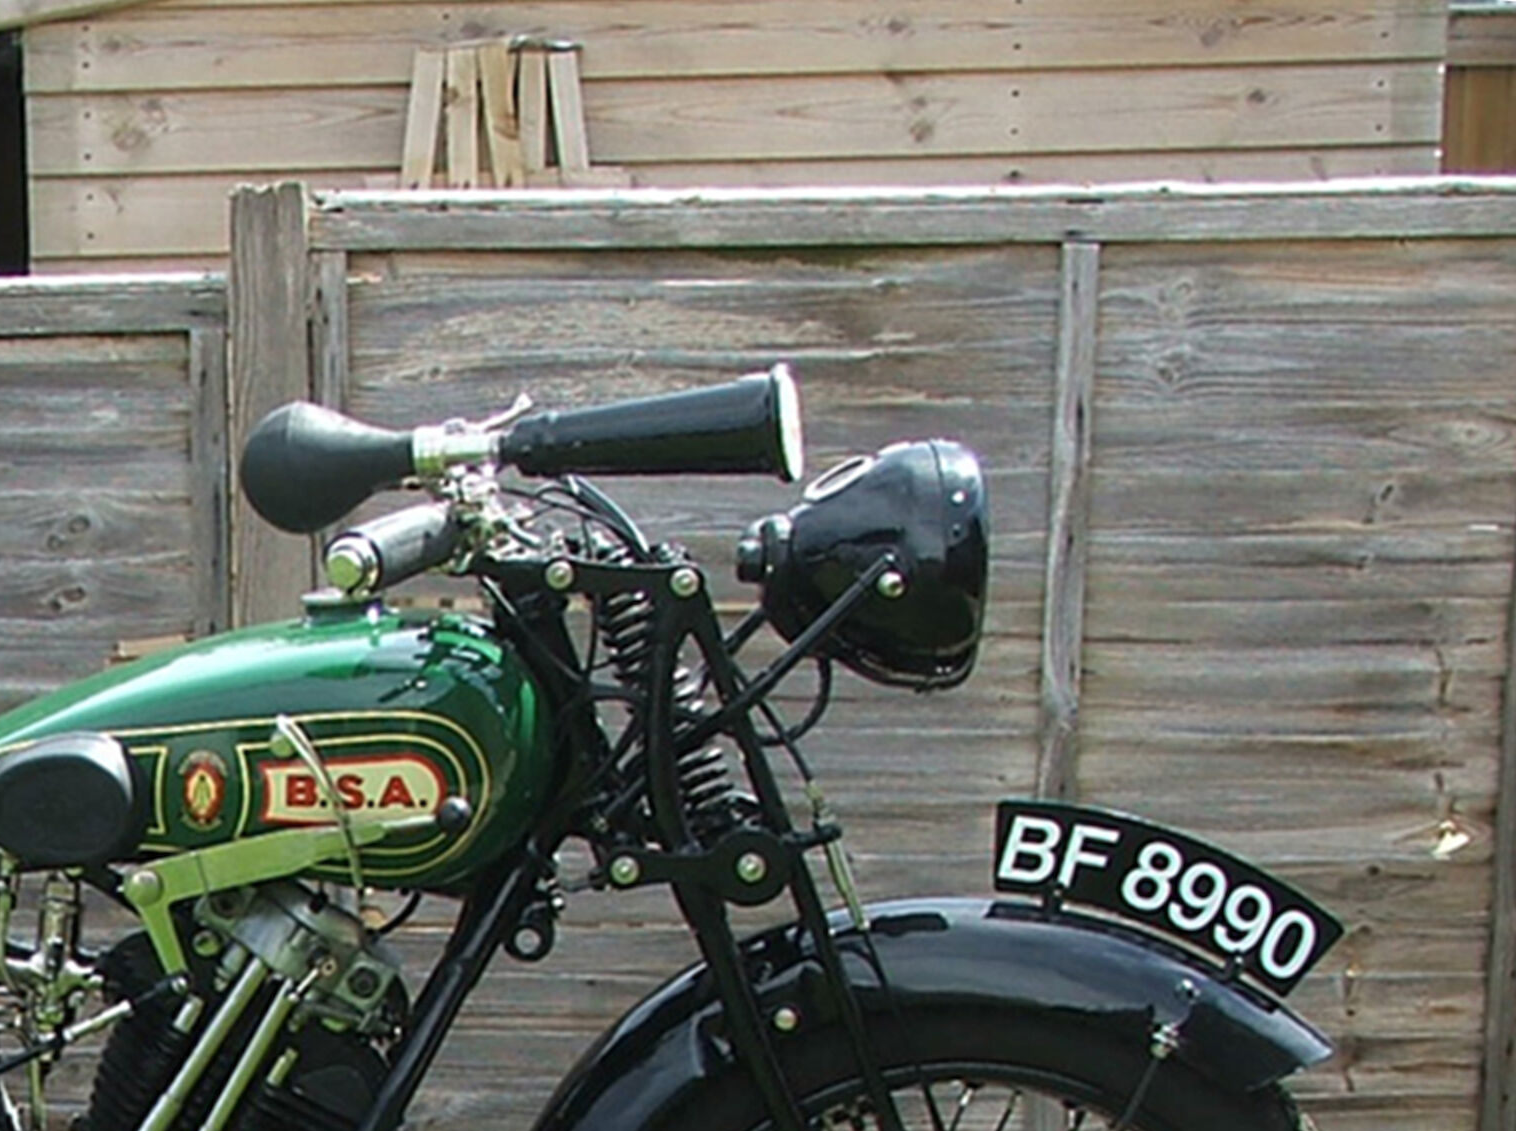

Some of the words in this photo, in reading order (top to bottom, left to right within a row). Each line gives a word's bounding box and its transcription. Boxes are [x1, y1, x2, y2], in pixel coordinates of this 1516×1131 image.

[286, 774, 427, 808] B.S.A.
[997, 815, 1120, 888] BF
[1121, 841, 1316, 979] 8990
